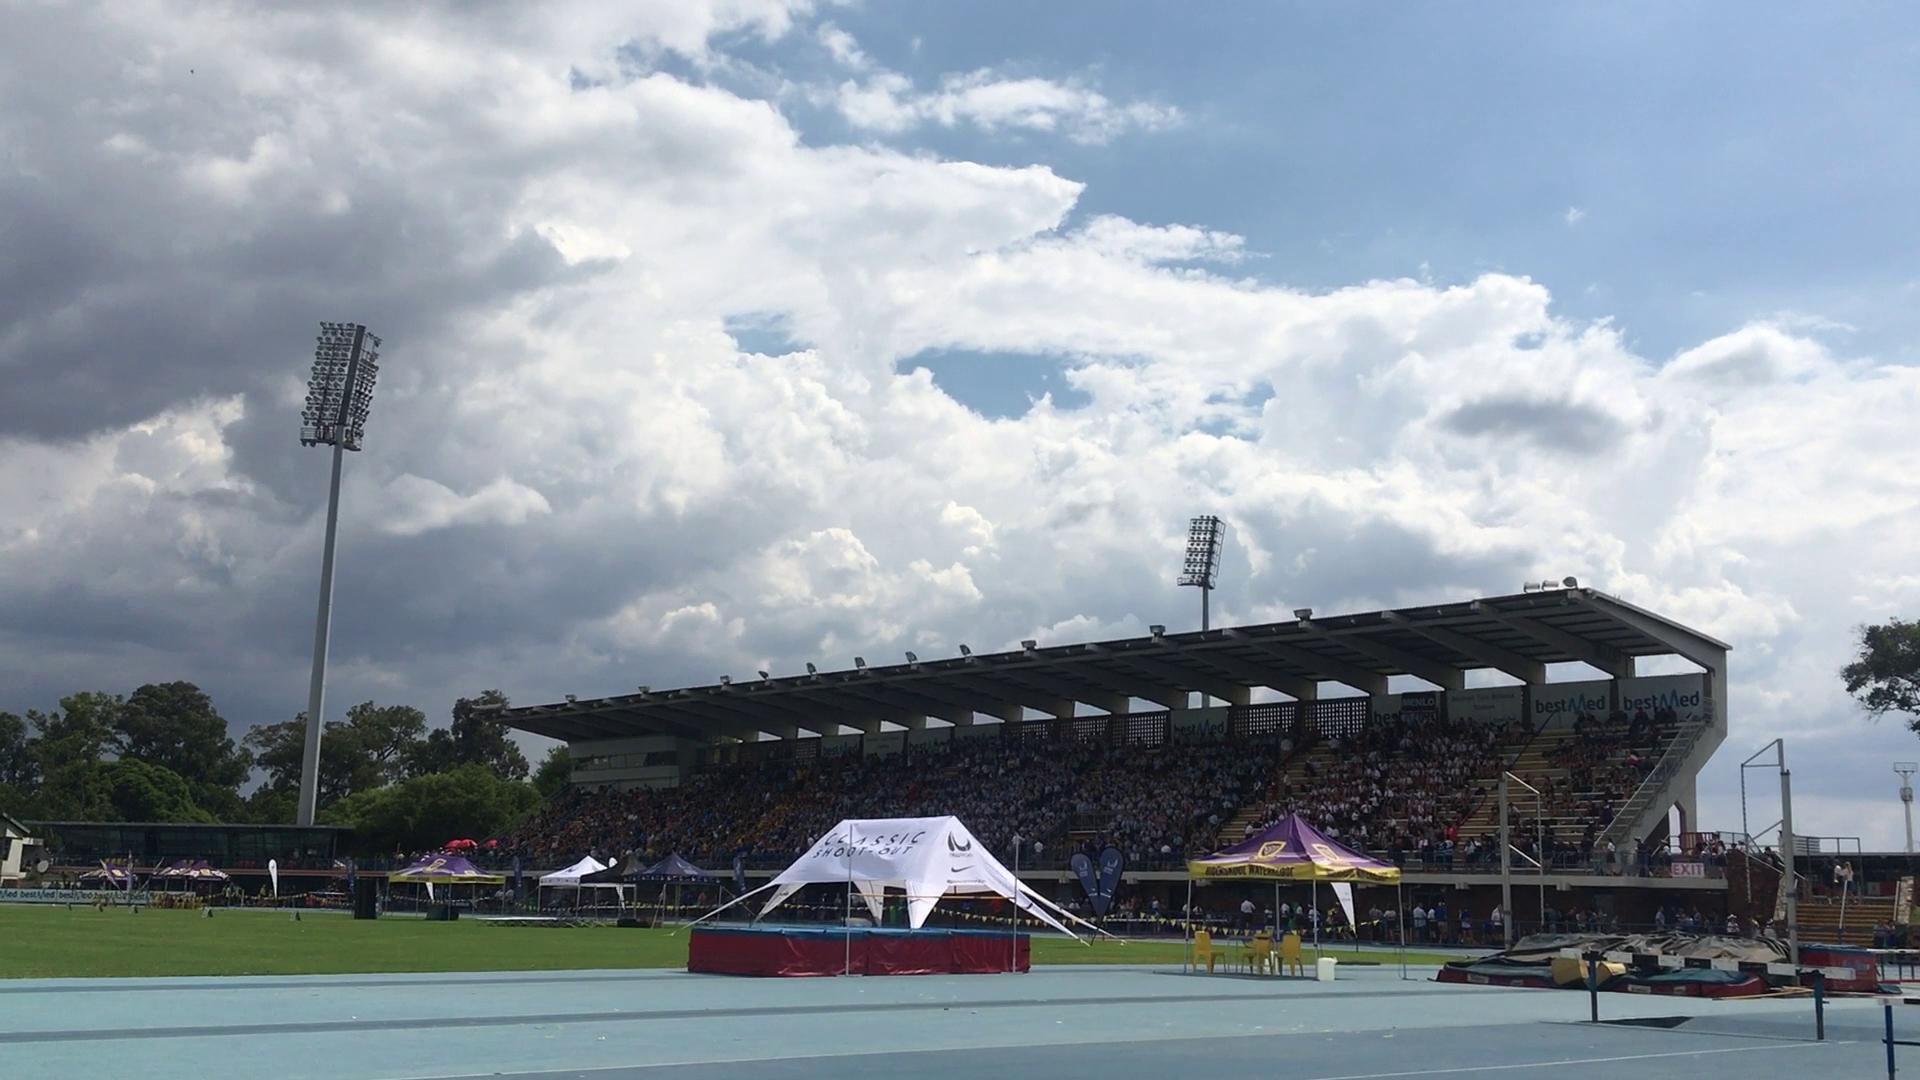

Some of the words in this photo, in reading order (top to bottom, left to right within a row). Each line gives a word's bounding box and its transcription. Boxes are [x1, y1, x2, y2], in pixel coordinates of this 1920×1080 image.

[1535, 694, 1605, 713] bestMed
[1623, 689, 1700, 711] bestMed
[824, 831, 926, 846] CLASSIC
[813, 846, 913, 859] SHOOT-OUT
[1673, 864, 1703, 875] EXIT
